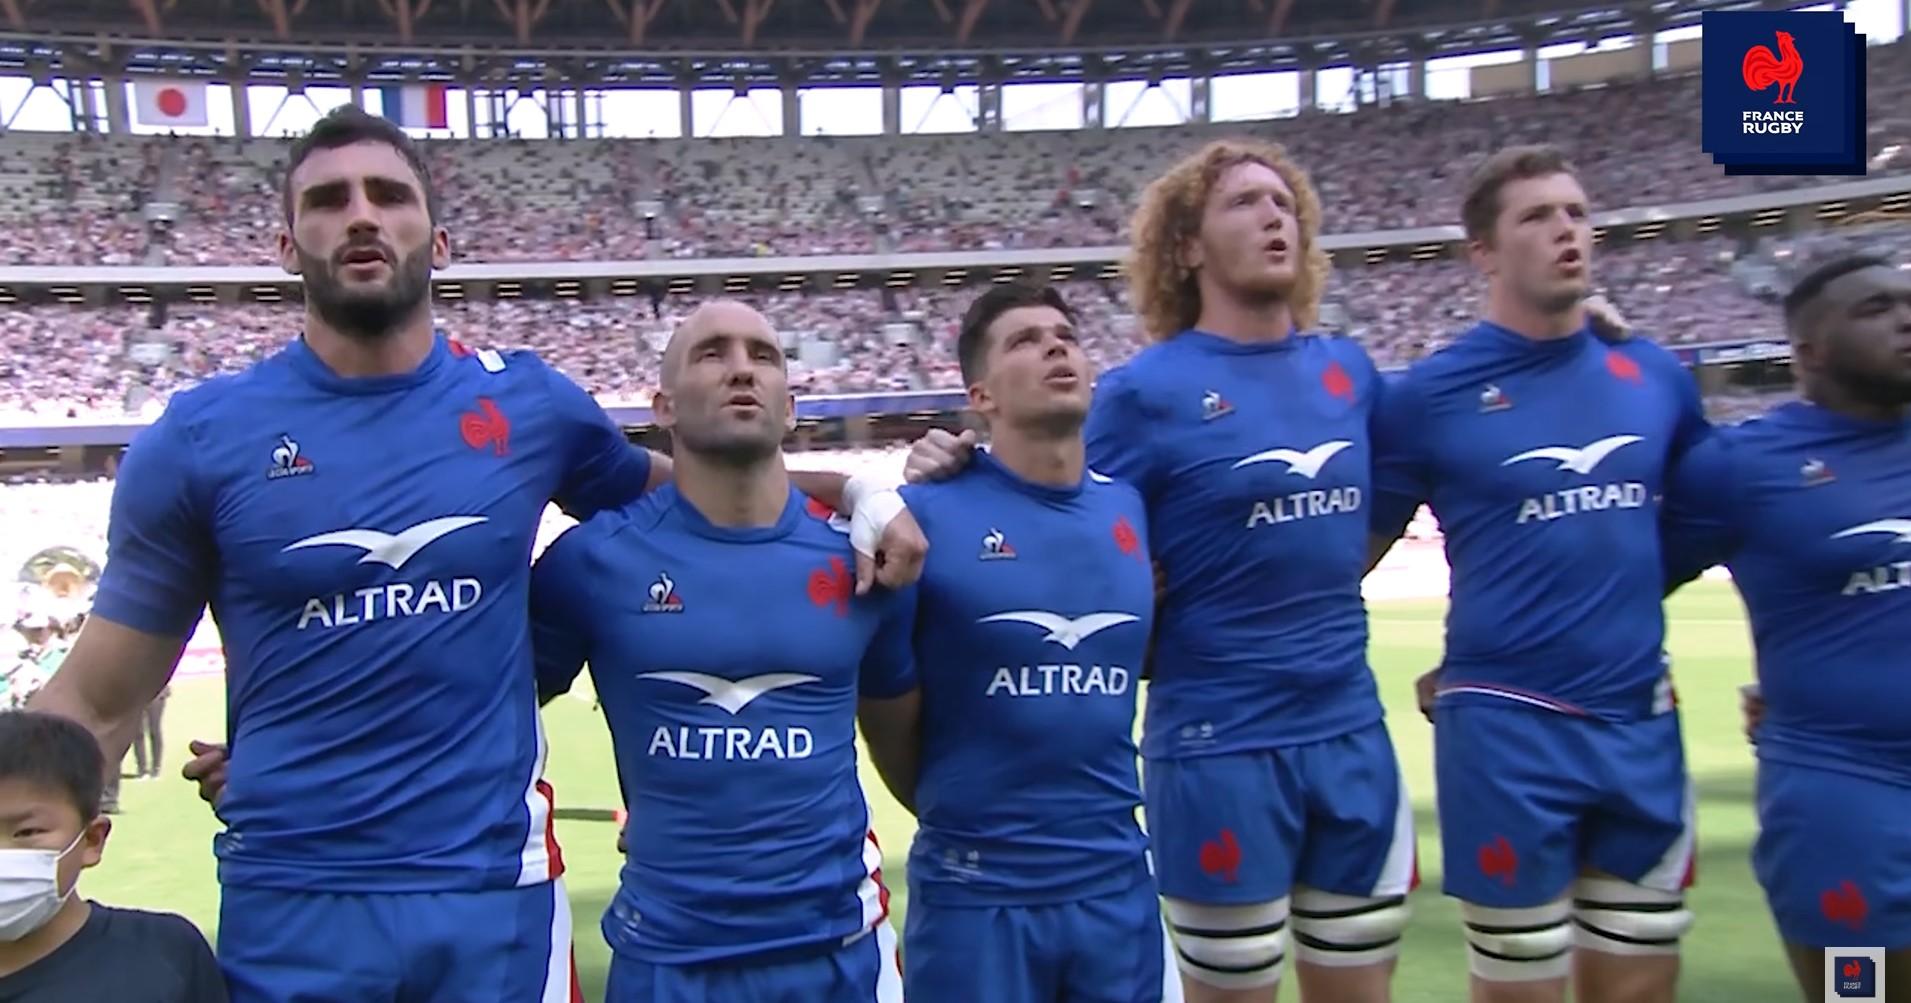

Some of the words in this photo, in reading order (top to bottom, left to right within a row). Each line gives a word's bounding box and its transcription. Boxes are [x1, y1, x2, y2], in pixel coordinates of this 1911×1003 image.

[1245, 486, 1362, 528] ALTRAD
[1515, 483, 1647, 524] ALTRAD
[297, 578, 482, 630] ALTRAD
[984, 664, 1130, 696] ALTRAD
[648, 726, 814, 760] ALTRAD
